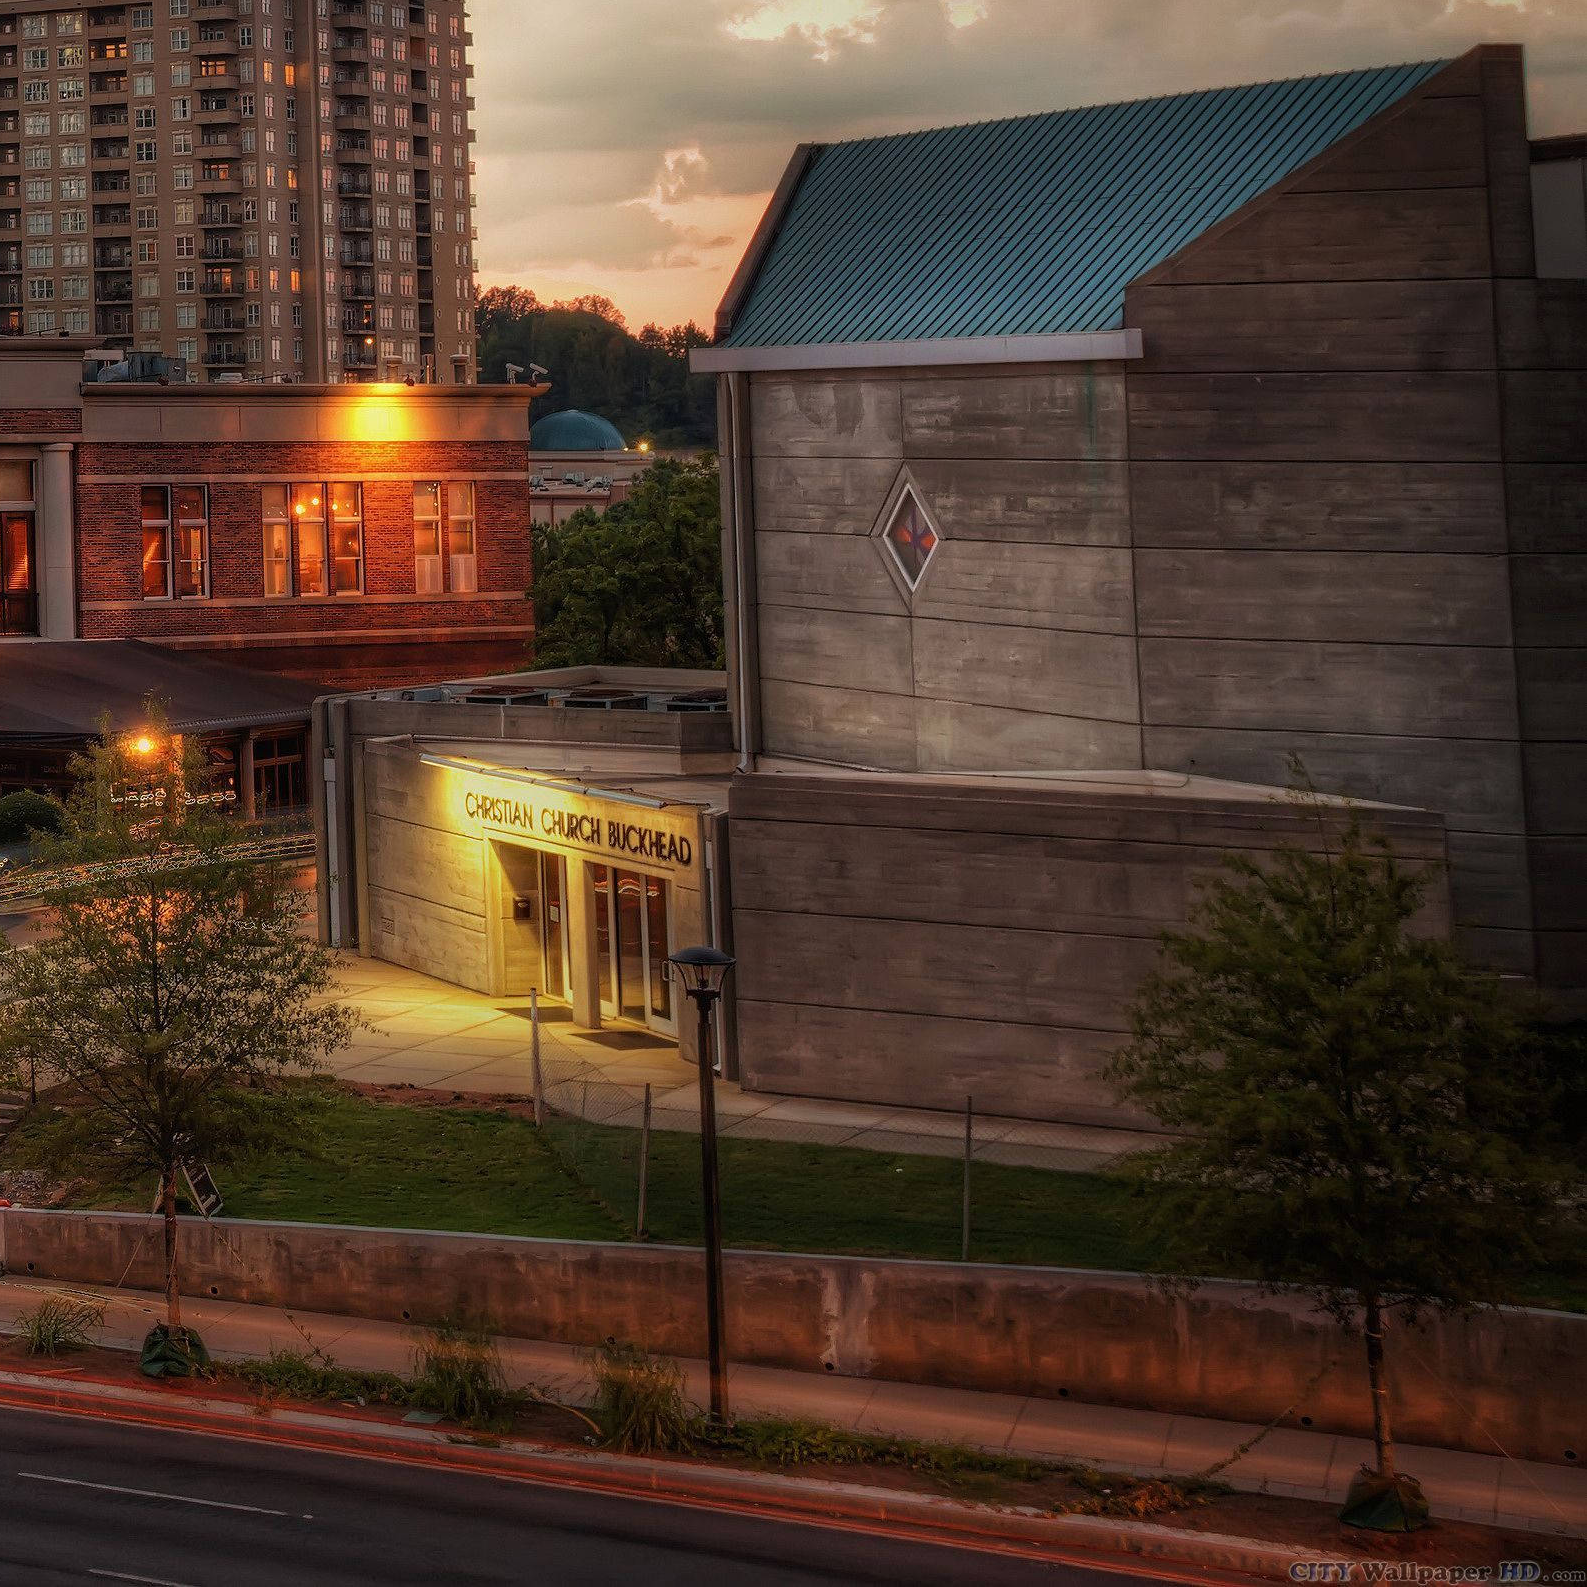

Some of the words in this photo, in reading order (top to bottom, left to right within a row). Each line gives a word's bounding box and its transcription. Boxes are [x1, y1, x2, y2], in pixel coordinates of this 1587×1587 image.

[465, 792, 533, 830] CHRISTIAN
[541, 808, 600, 845] CHURCH
[608, 820, 692, 864] BUCKHEAD
